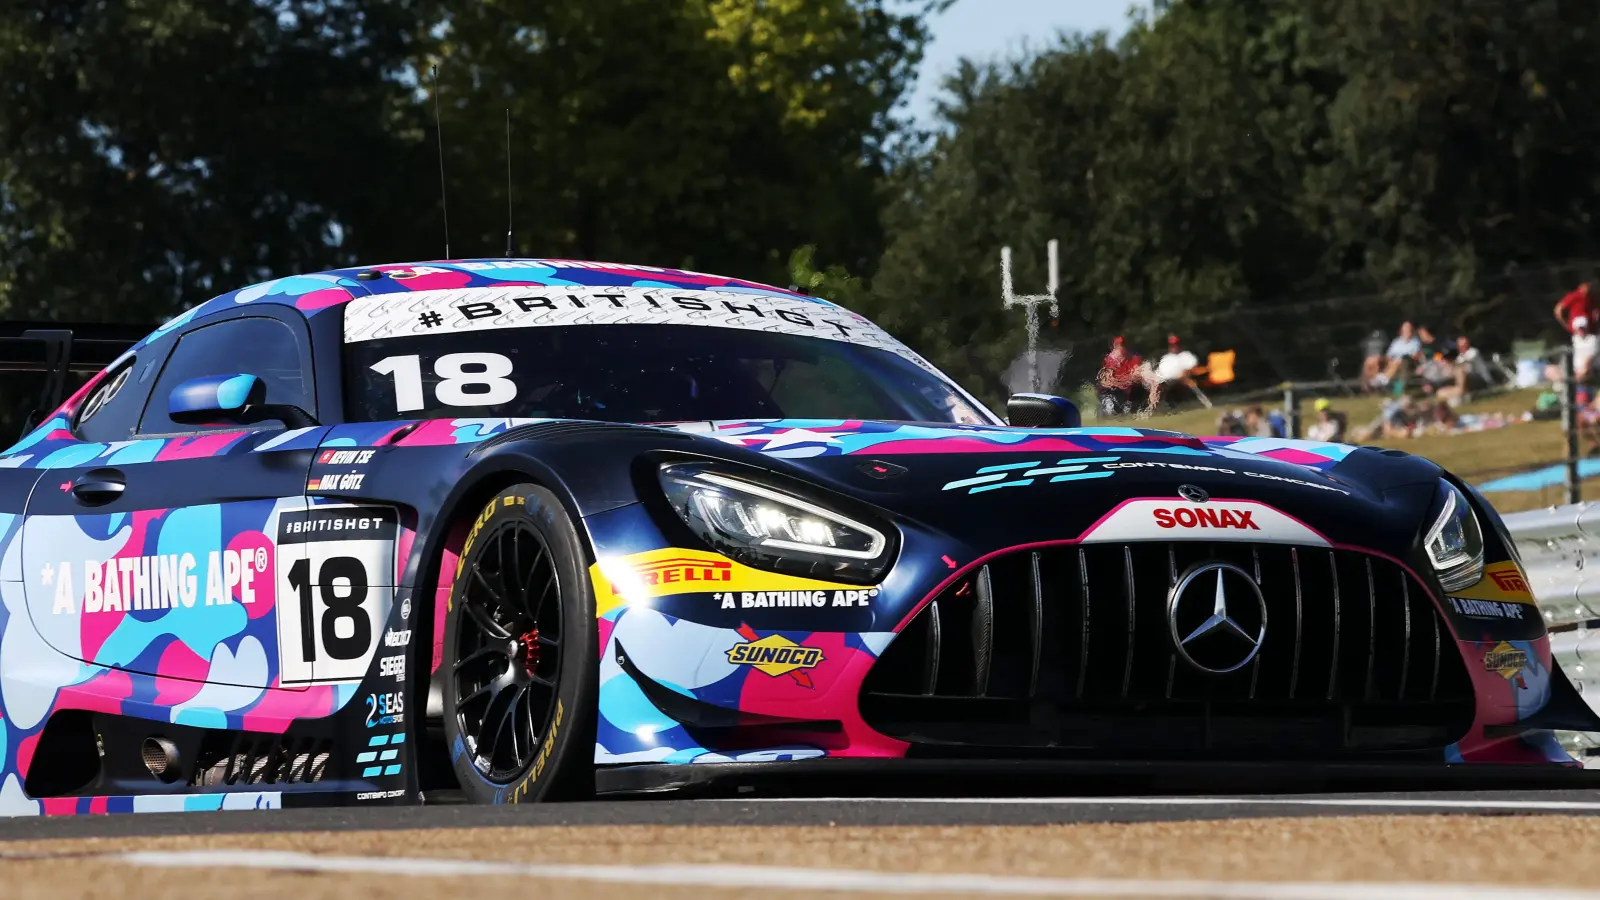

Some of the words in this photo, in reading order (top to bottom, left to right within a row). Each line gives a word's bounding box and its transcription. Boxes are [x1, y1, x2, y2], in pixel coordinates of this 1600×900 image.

[418, 294, 852, 337] #BRITISHGT
[369, 352, 517, 412] 18
[328, 450, 361, 464] KEVIN
[355, 450, 376, 464] TSE
[319, 474, 342, 490] MAX
[339, 469, 365, 490] GÖTZ
[1102, 462, 1236, 475] CONTEMPO
[1243, 471, 1350, 496] CONCEPT
[286, 518, 383, 534] #BRITISHGT
[1153, 508, 1261, 530] SONAX
[457, 496, 499, 580] ZERO
[85, 552, 198, 614] BATHING
[288, 556, 372, 662] 18
[742, 590, 826, 609] BATHING
[1460, 598, 1504, 617] BATHING
[733, 644, 819, 666] SUNOCO
[1485, 651, 1527, 669] SUNOCO
[379, 692, 404, 715] SEAS
[514, 698, 563, 805] PIRELLI
